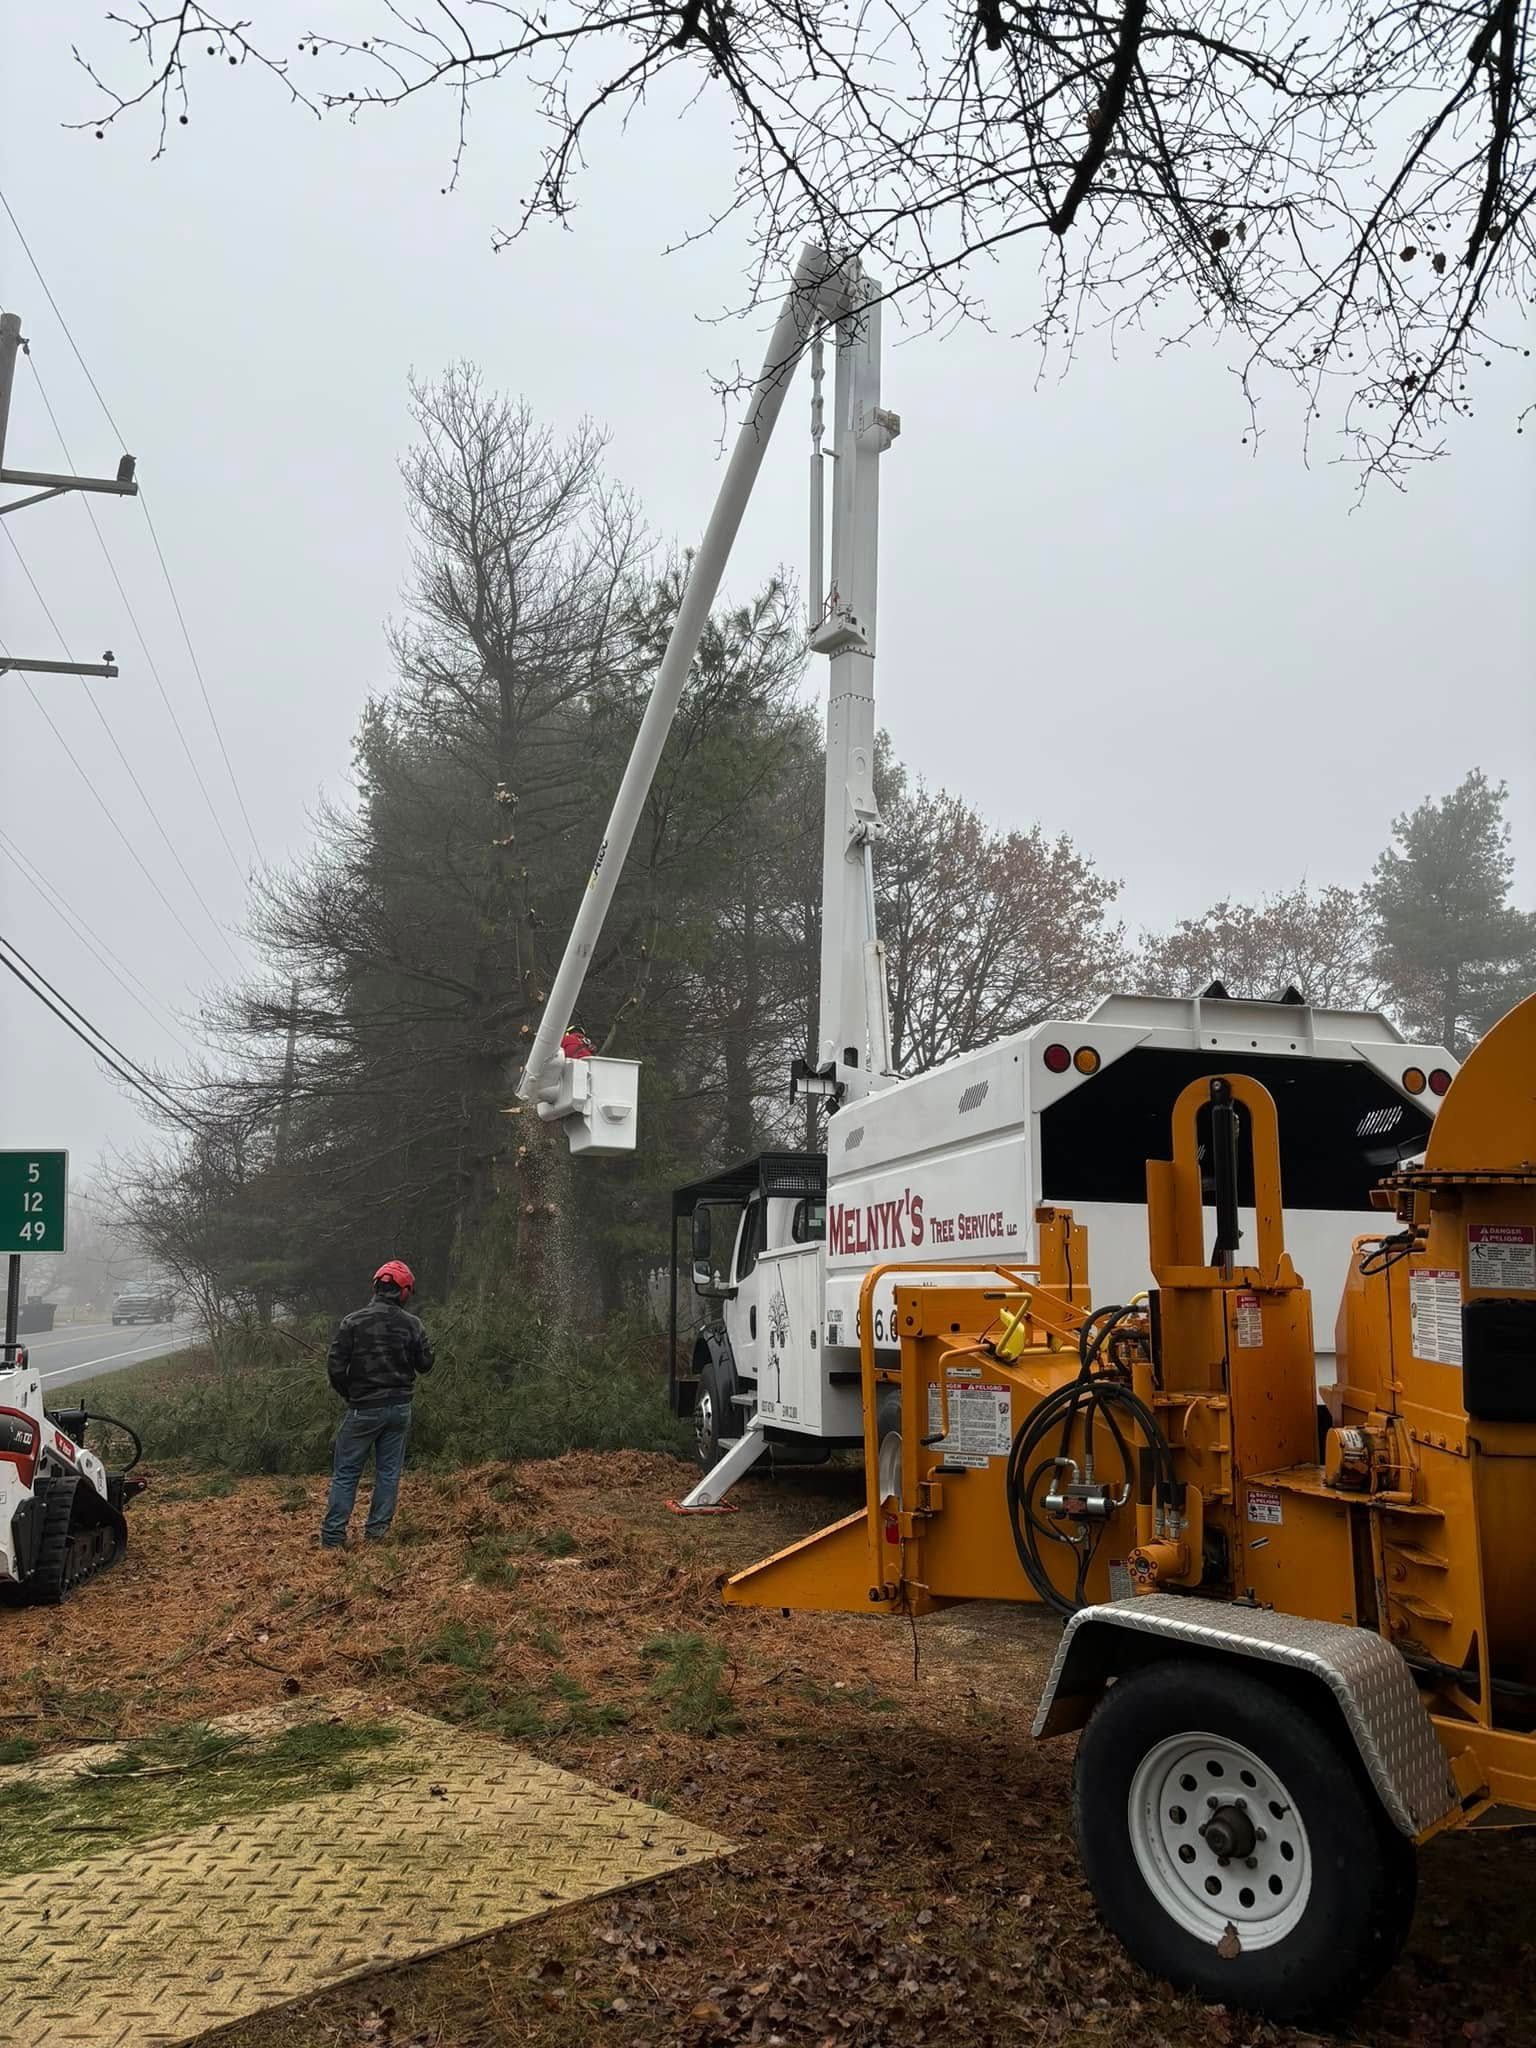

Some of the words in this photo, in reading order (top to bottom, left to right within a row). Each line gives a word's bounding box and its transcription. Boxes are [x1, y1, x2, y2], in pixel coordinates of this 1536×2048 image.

[28, 1163, 40, 1183] 5
[23, 1192, 43, 1212] 12
[19, 1221, 46, 1241] 49
[829, 1188, 924, 1256] MELNYK'S
[930, 1217, 955, 1244] TREE
[958, 1210, 1004, 1240] SERVICE
[1489, 1227, 1521, 1235] DANGER
